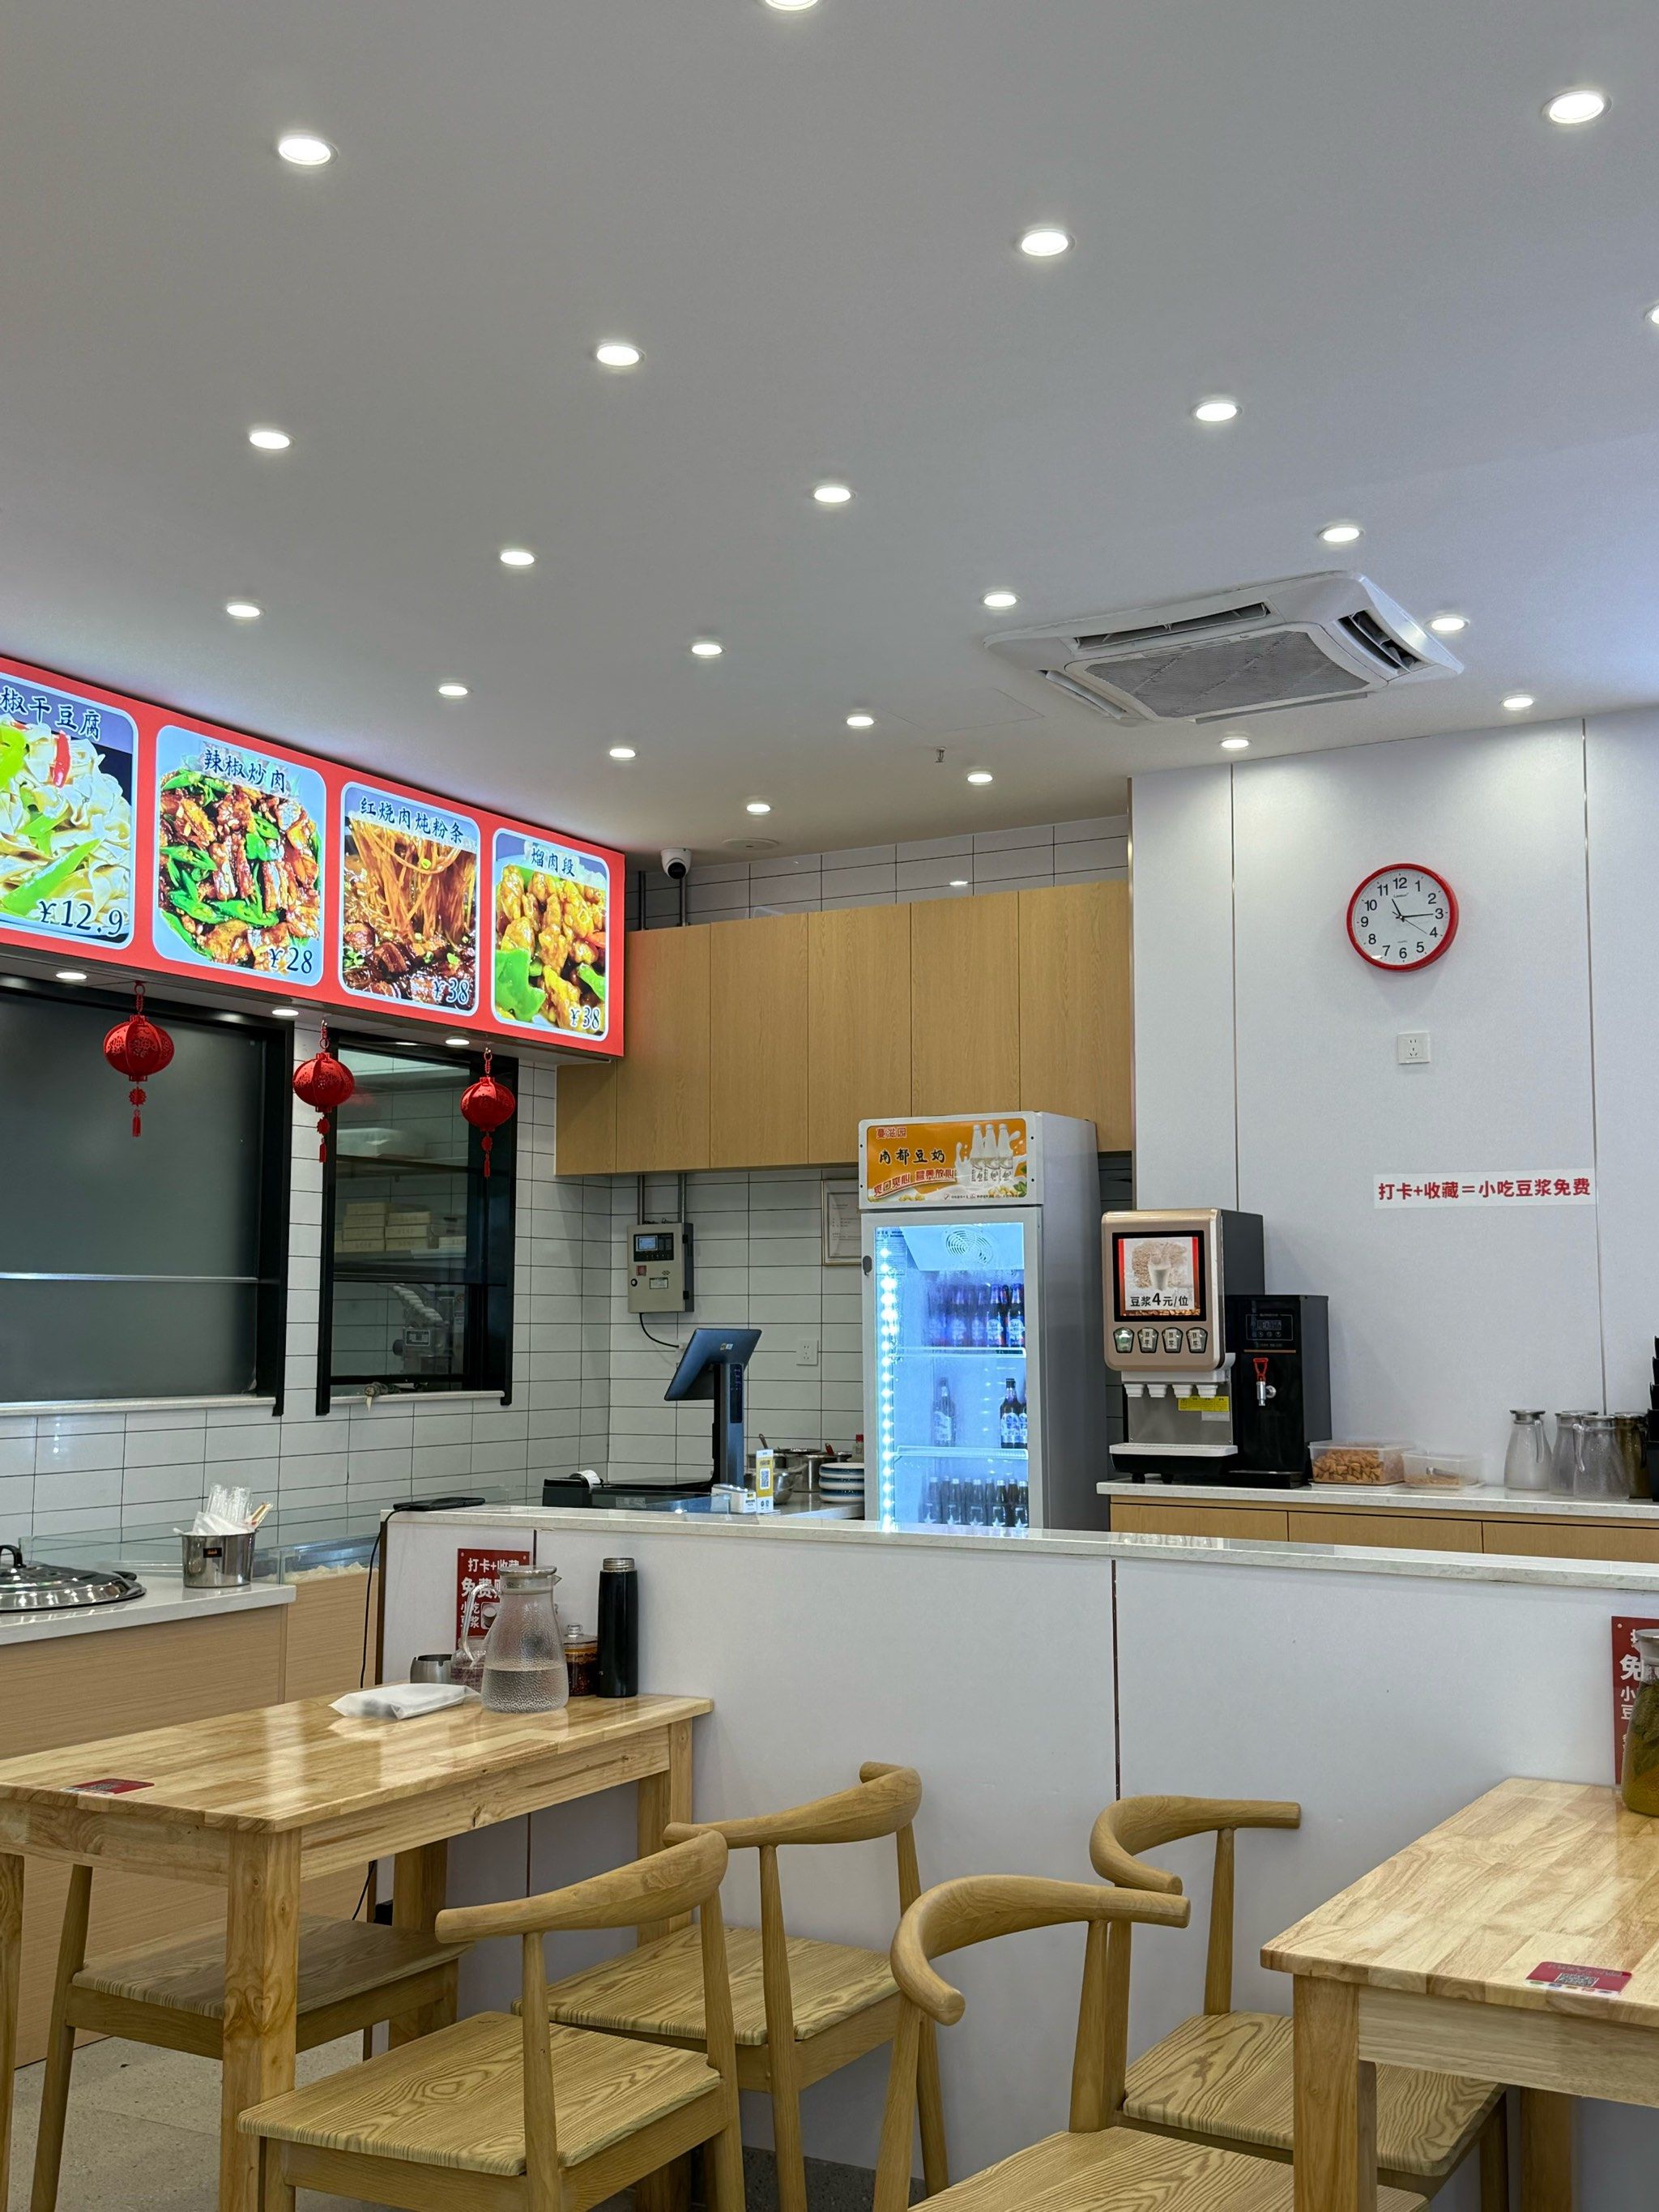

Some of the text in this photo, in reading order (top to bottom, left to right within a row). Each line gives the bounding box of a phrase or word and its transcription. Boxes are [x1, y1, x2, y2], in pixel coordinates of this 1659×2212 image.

[205, 749, 285, 793] 辣椒炒肉
[360, 797, 463, 843] 红烧肉炖粉条
[1377, 884, 1388, 896] 11
[1393, 878, 1408, 890] 12
[1415, 880, 1421, 892] 1
[1427, 893, 1436, 904] 2
[1364, 899, 1377, 911] 10
[40, 899, 123, 935] ¥12.9
[1435, 908, 1444, 920] 3
[1361, 916, 1369, 927] 9
[1430, 927, 1438, 937] 4
[1368, 933, 1376, 945] 8
[1382, 945, 1391, 956] 7
[1399, 947, 1407, 959] 6
[1417, 942, 1424, 953] 5
[269, 946, 313, 974] ¥28
[434, 978, 469, 1005] ¥38
[569, 1006, 600, 1029] ¥38
[1379, 1177, 1591, 1201] 打卡+收藏=小吃豆浆免费
[1130, 1292, 1189, 1307] 豆浆4元/位
